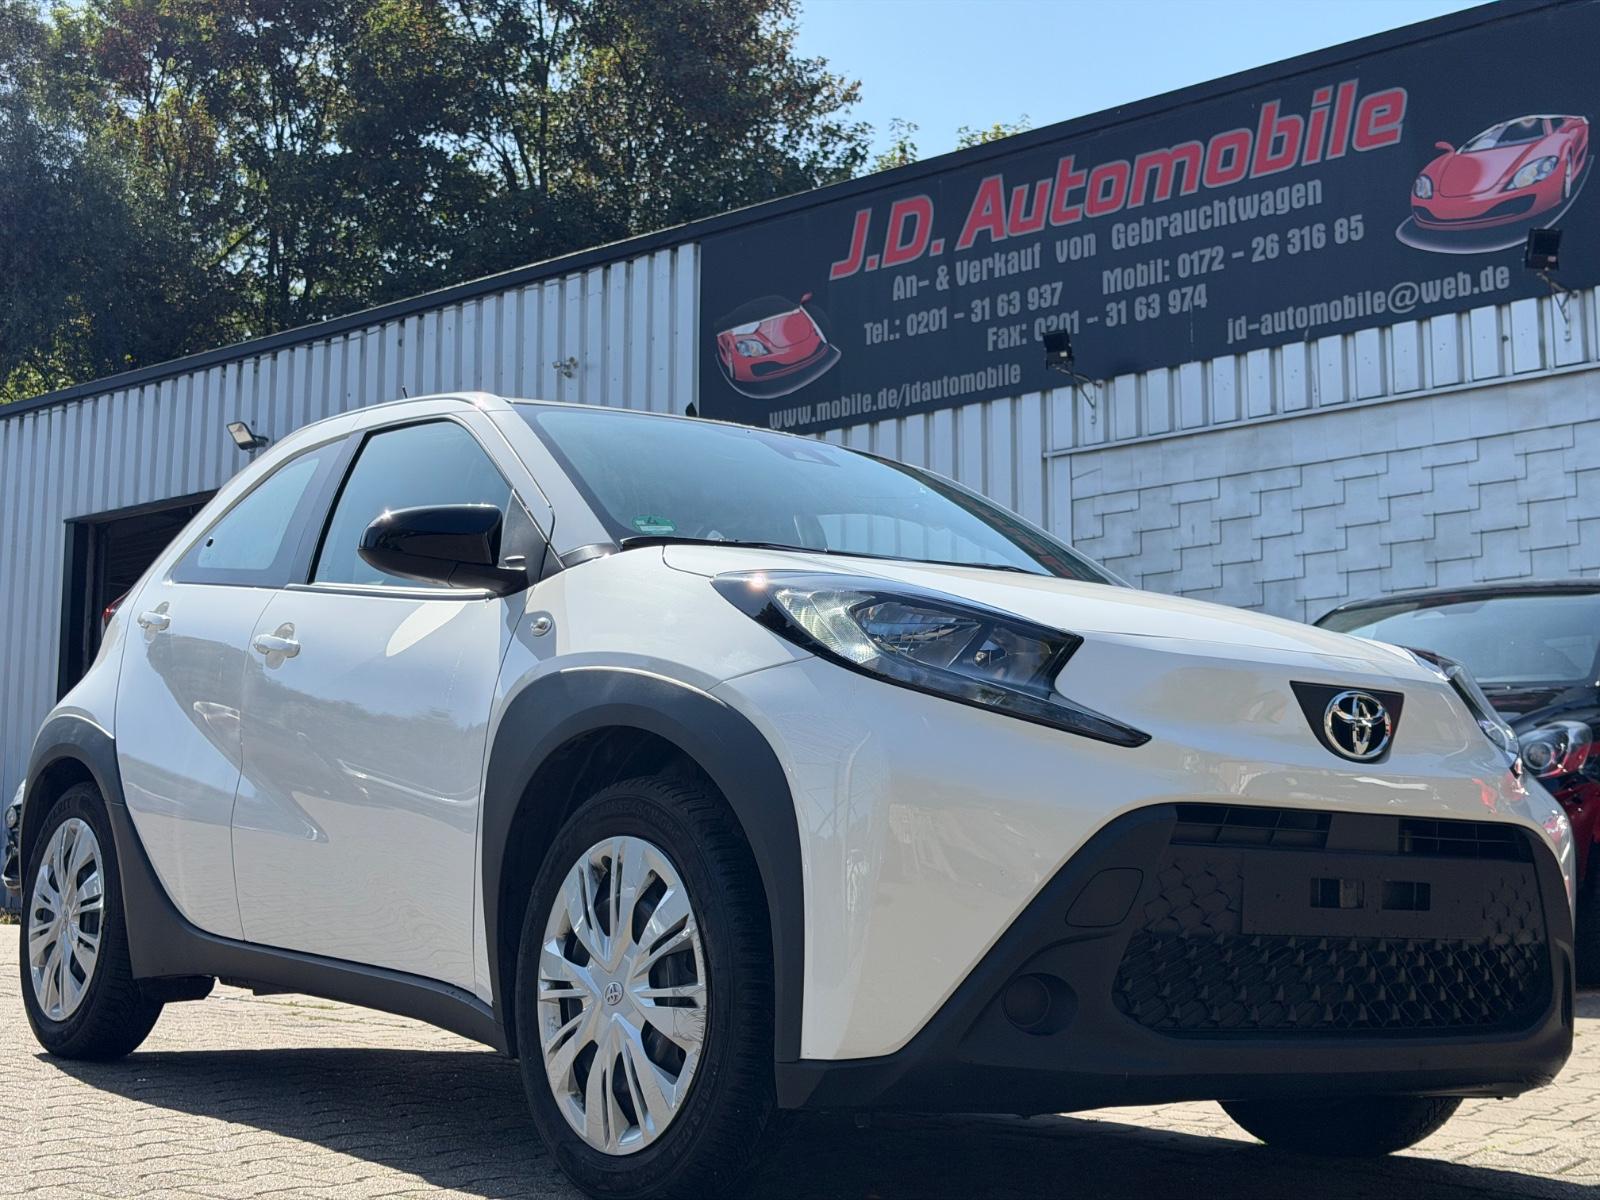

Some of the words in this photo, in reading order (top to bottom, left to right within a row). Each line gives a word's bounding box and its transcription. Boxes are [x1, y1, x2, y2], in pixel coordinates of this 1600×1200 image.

[829, 194, 945, 280] J.D.
[954, 78, 1409, 251] Automobile
[893, 275, 930, 302] An-
[936, 265, 950, 291] &
[956, 243, 1041, 286] Verkauf
[1056, 233, 1096, 263] von
[1112, 179, 1323, 251] Gebrauchtwagen
[1102, 258, 1171, 295] Mobil:
[1177, 246, 1225, 278] 0172
[1252, 233, 1280, 263] 26
[1287, 223, 1326, 254] 316
[1334, 214, 1365, 245] 85
[864, 319, 901, 346] Tel.:
[907, 307, 949, 336] 0201
[971, 297, 990, 323] 31
[997, 291, 1021, 318] 63
[1027, 281, 1063, 311] 937
[987, 323, 1027, 351] Fax:
[1106, 300, 1127, 327] 31
[1134, 293, 1160, 322] 63
[1168, 283, 1208, 314] 974
[1227, 265, 1510, 344] jd-automobile@web.de
[769, 363, 1022, 430] www.mobile.de/jdautomobile
